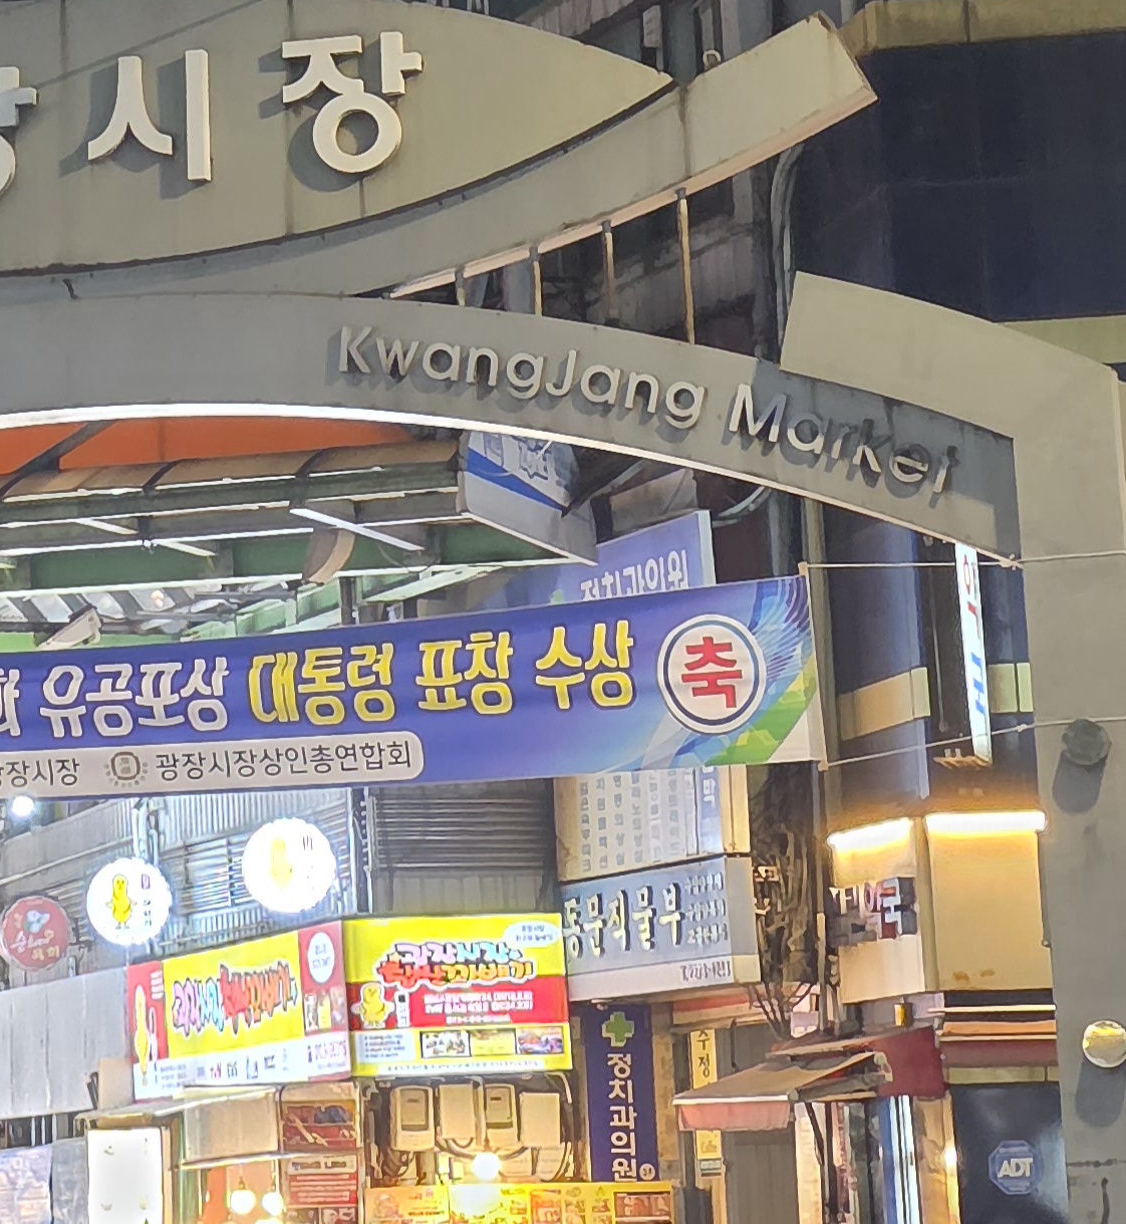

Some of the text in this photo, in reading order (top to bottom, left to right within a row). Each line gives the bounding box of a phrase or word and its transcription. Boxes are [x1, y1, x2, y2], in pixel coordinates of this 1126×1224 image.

[338, 326, 959, 495] KwangJang Market
[38, 656, 231, 738] 유공포상
[248, 642, 396, 727] 대통령
[416, 631, 514, 715] 표창
[534, 619, 635, 710] 수상
[680, 635, 744, 710] 축
[155, 740, 412, 782] 광장시장상인총연합회
[562, 882, 684, 958] 동문직물부
[607, 1053, 638, 1183] 정치과의원
[997, 1157, 1034, 1178] ADT
